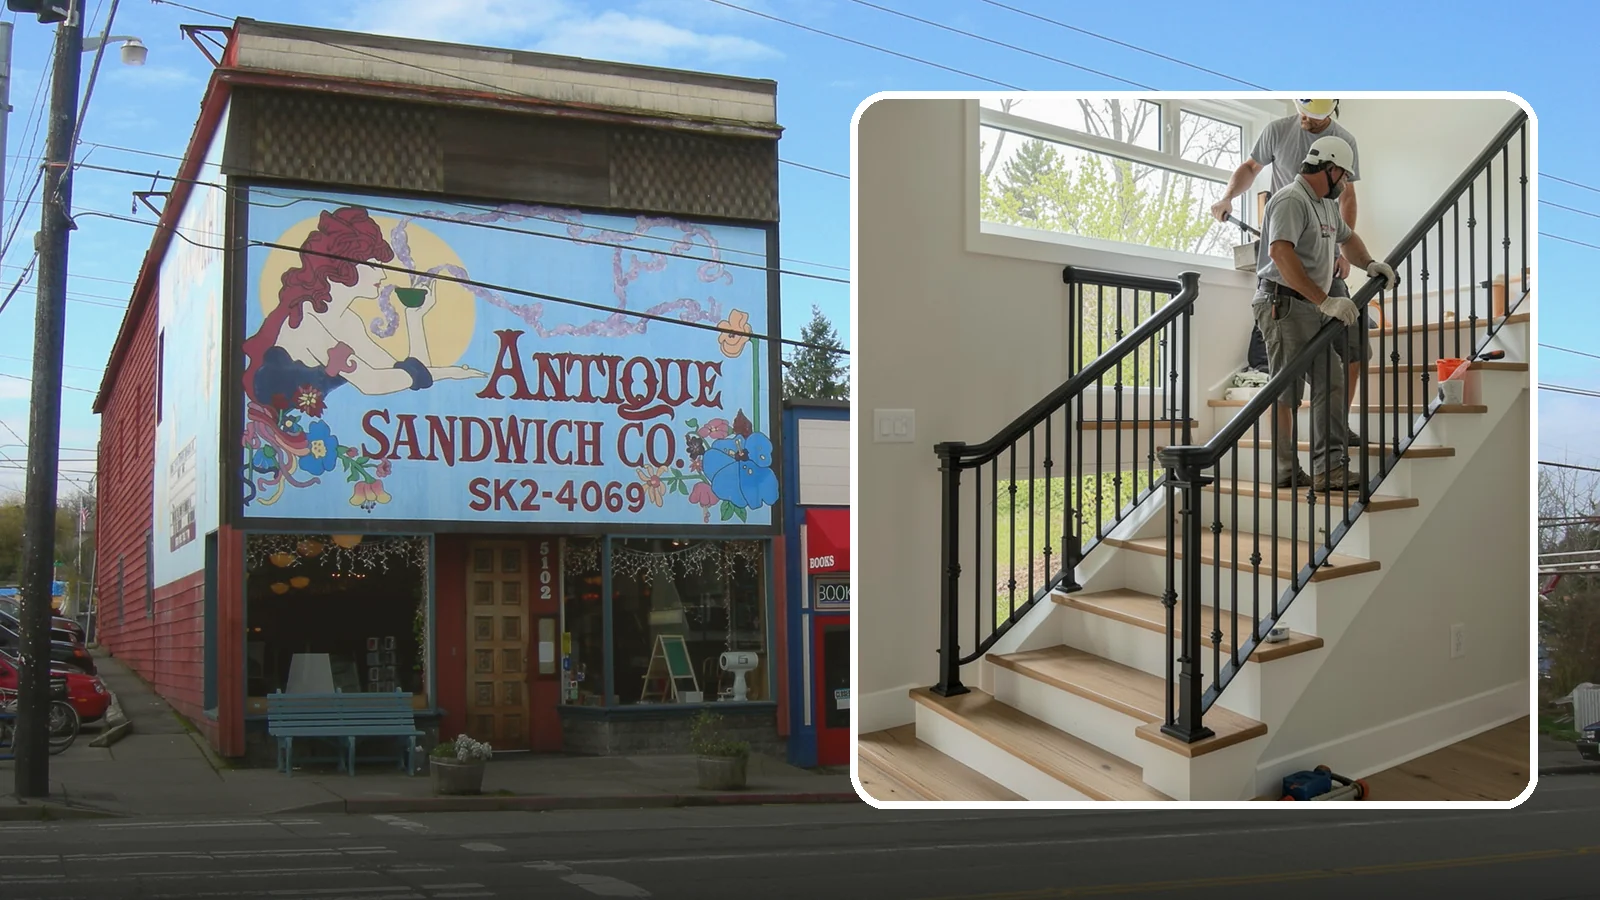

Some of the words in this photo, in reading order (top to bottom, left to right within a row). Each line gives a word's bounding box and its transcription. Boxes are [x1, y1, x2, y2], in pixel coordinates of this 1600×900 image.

[477, 329, 723, 420] ANTIQUE
[361, 408, 605, 467] SANDWICH
[617, 421, 684, 468] CO.
[468, 477, 645, 512] SK2-4069
[540, 541, 551, 599] 5102
[809, 555, 835, 569] BOOKS
